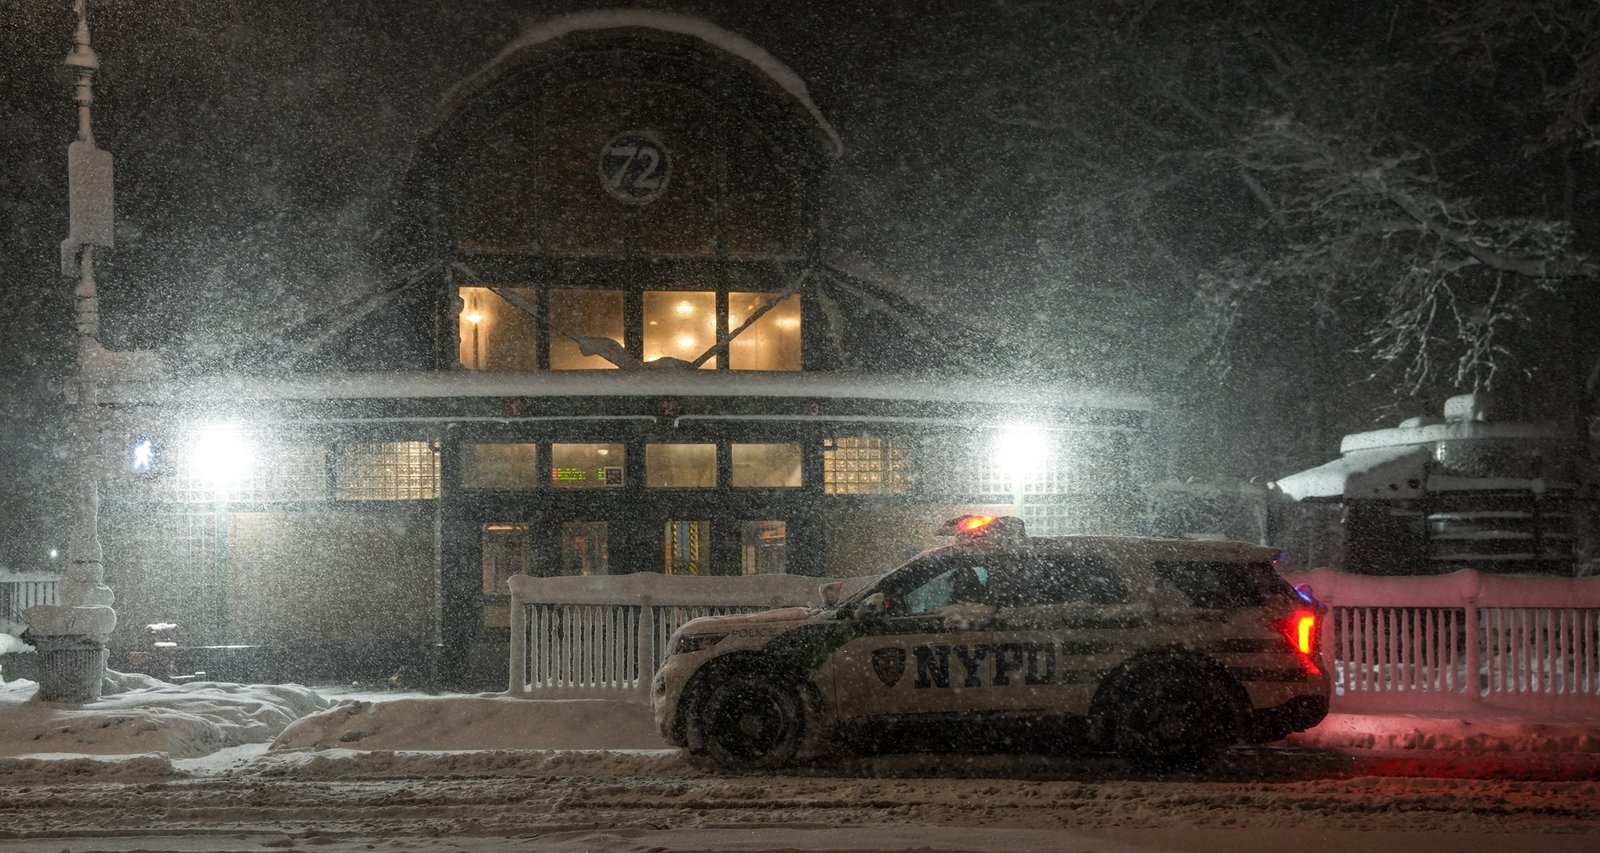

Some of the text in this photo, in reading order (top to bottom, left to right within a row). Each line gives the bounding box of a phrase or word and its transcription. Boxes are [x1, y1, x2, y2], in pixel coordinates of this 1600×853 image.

[609, 146, 659, 189] 72
[732, 627, 778, 638] POLICE
[913, 643, 1056, 689] NYPD
